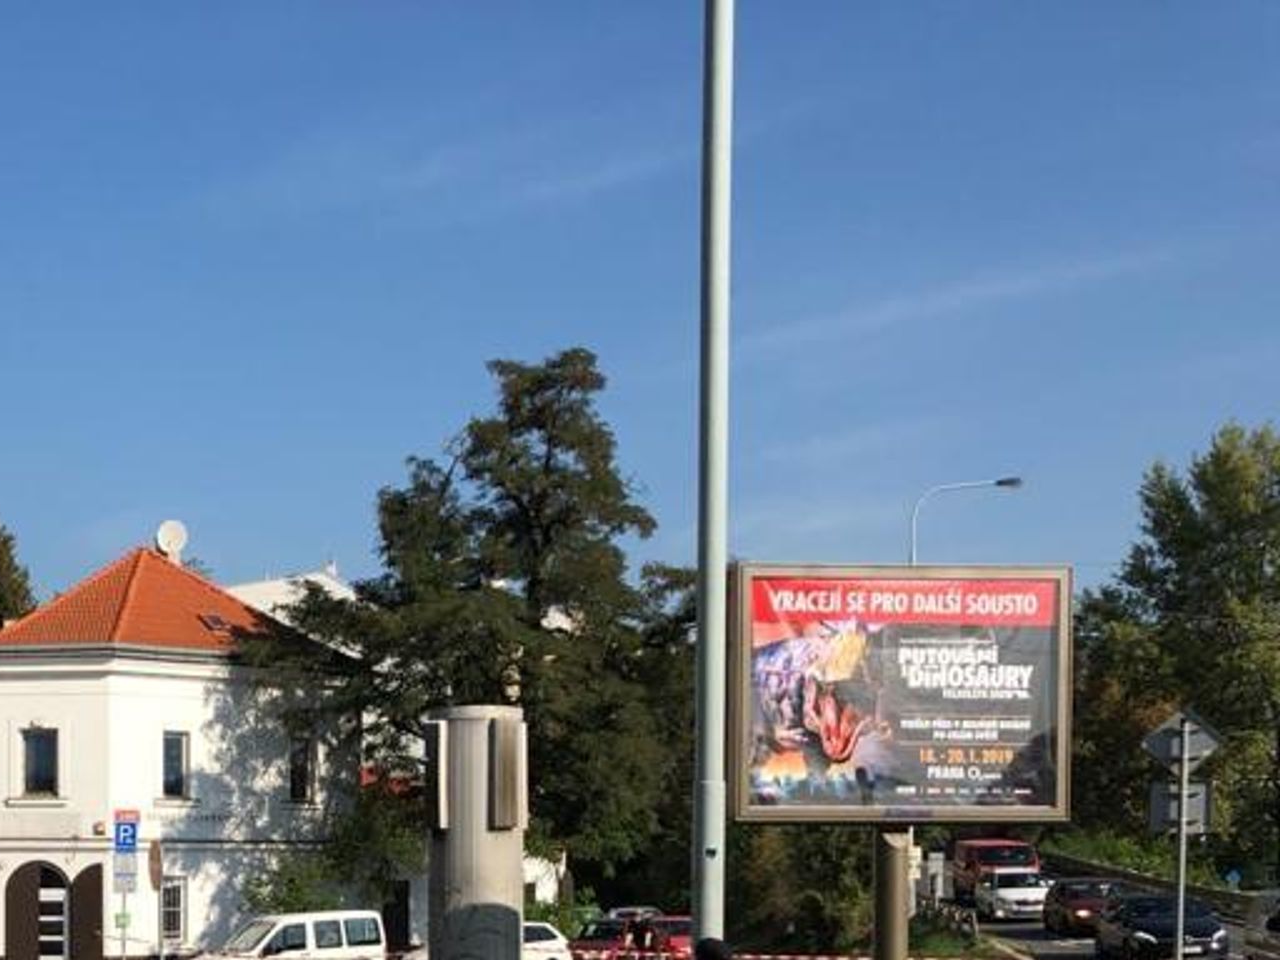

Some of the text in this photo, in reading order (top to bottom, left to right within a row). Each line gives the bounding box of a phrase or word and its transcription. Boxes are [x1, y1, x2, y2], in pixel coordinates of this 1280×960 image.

[772, 587, 1038, 615] VRACEJÍ SE PRO DALŠÍ SOUSTO
